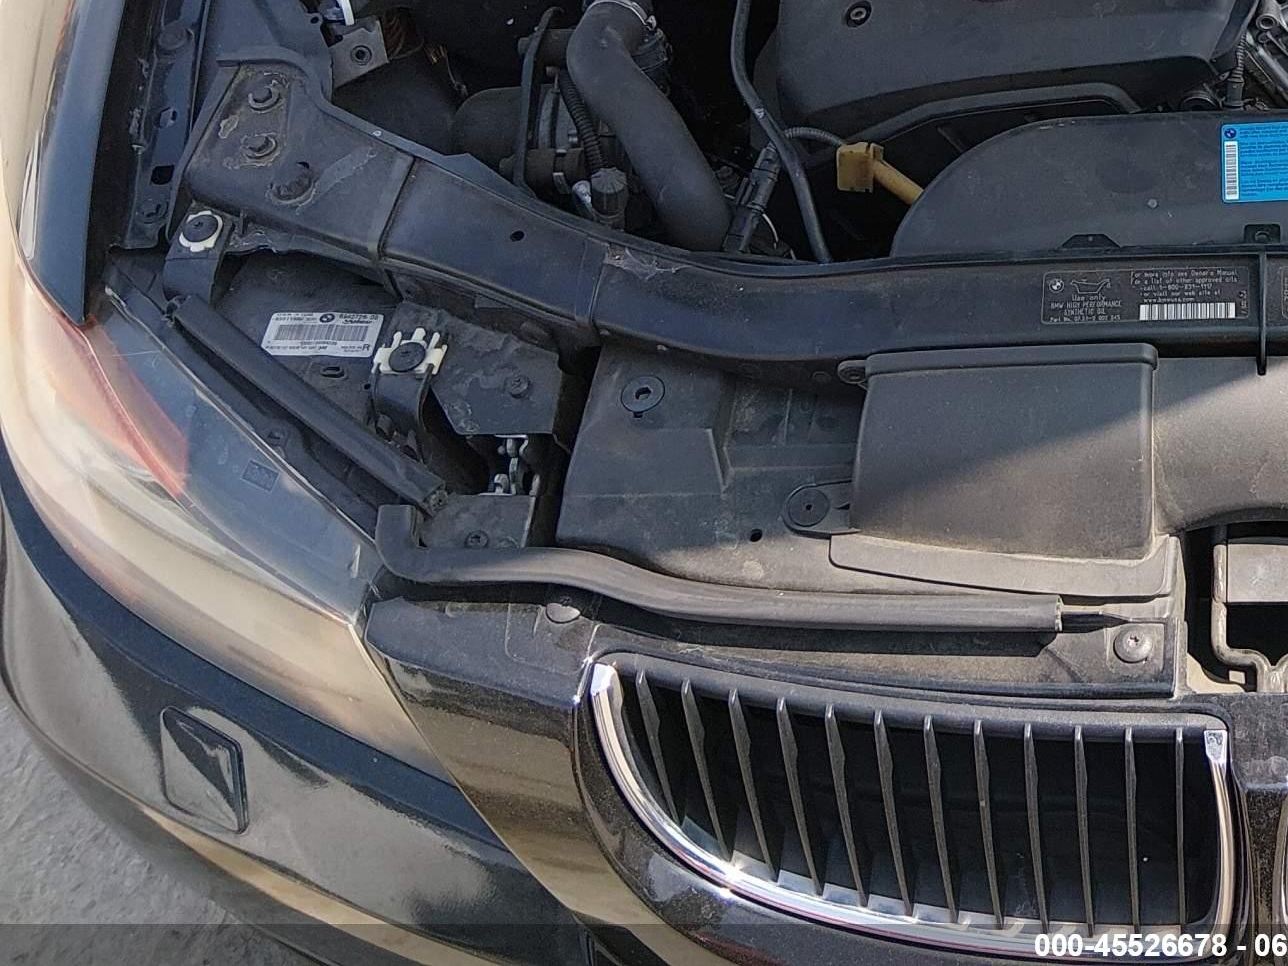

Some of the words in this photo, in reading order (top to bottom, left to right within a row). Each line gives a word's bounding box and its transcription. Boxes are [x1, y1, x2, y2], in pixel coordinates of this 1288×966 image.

[1089, 293, 1106, 302] only
[1066, 301, 1080, 309] HIGH
[1082, 300, 1121, 308] PERFORMANCE
[362, 343, 371, 351] R
